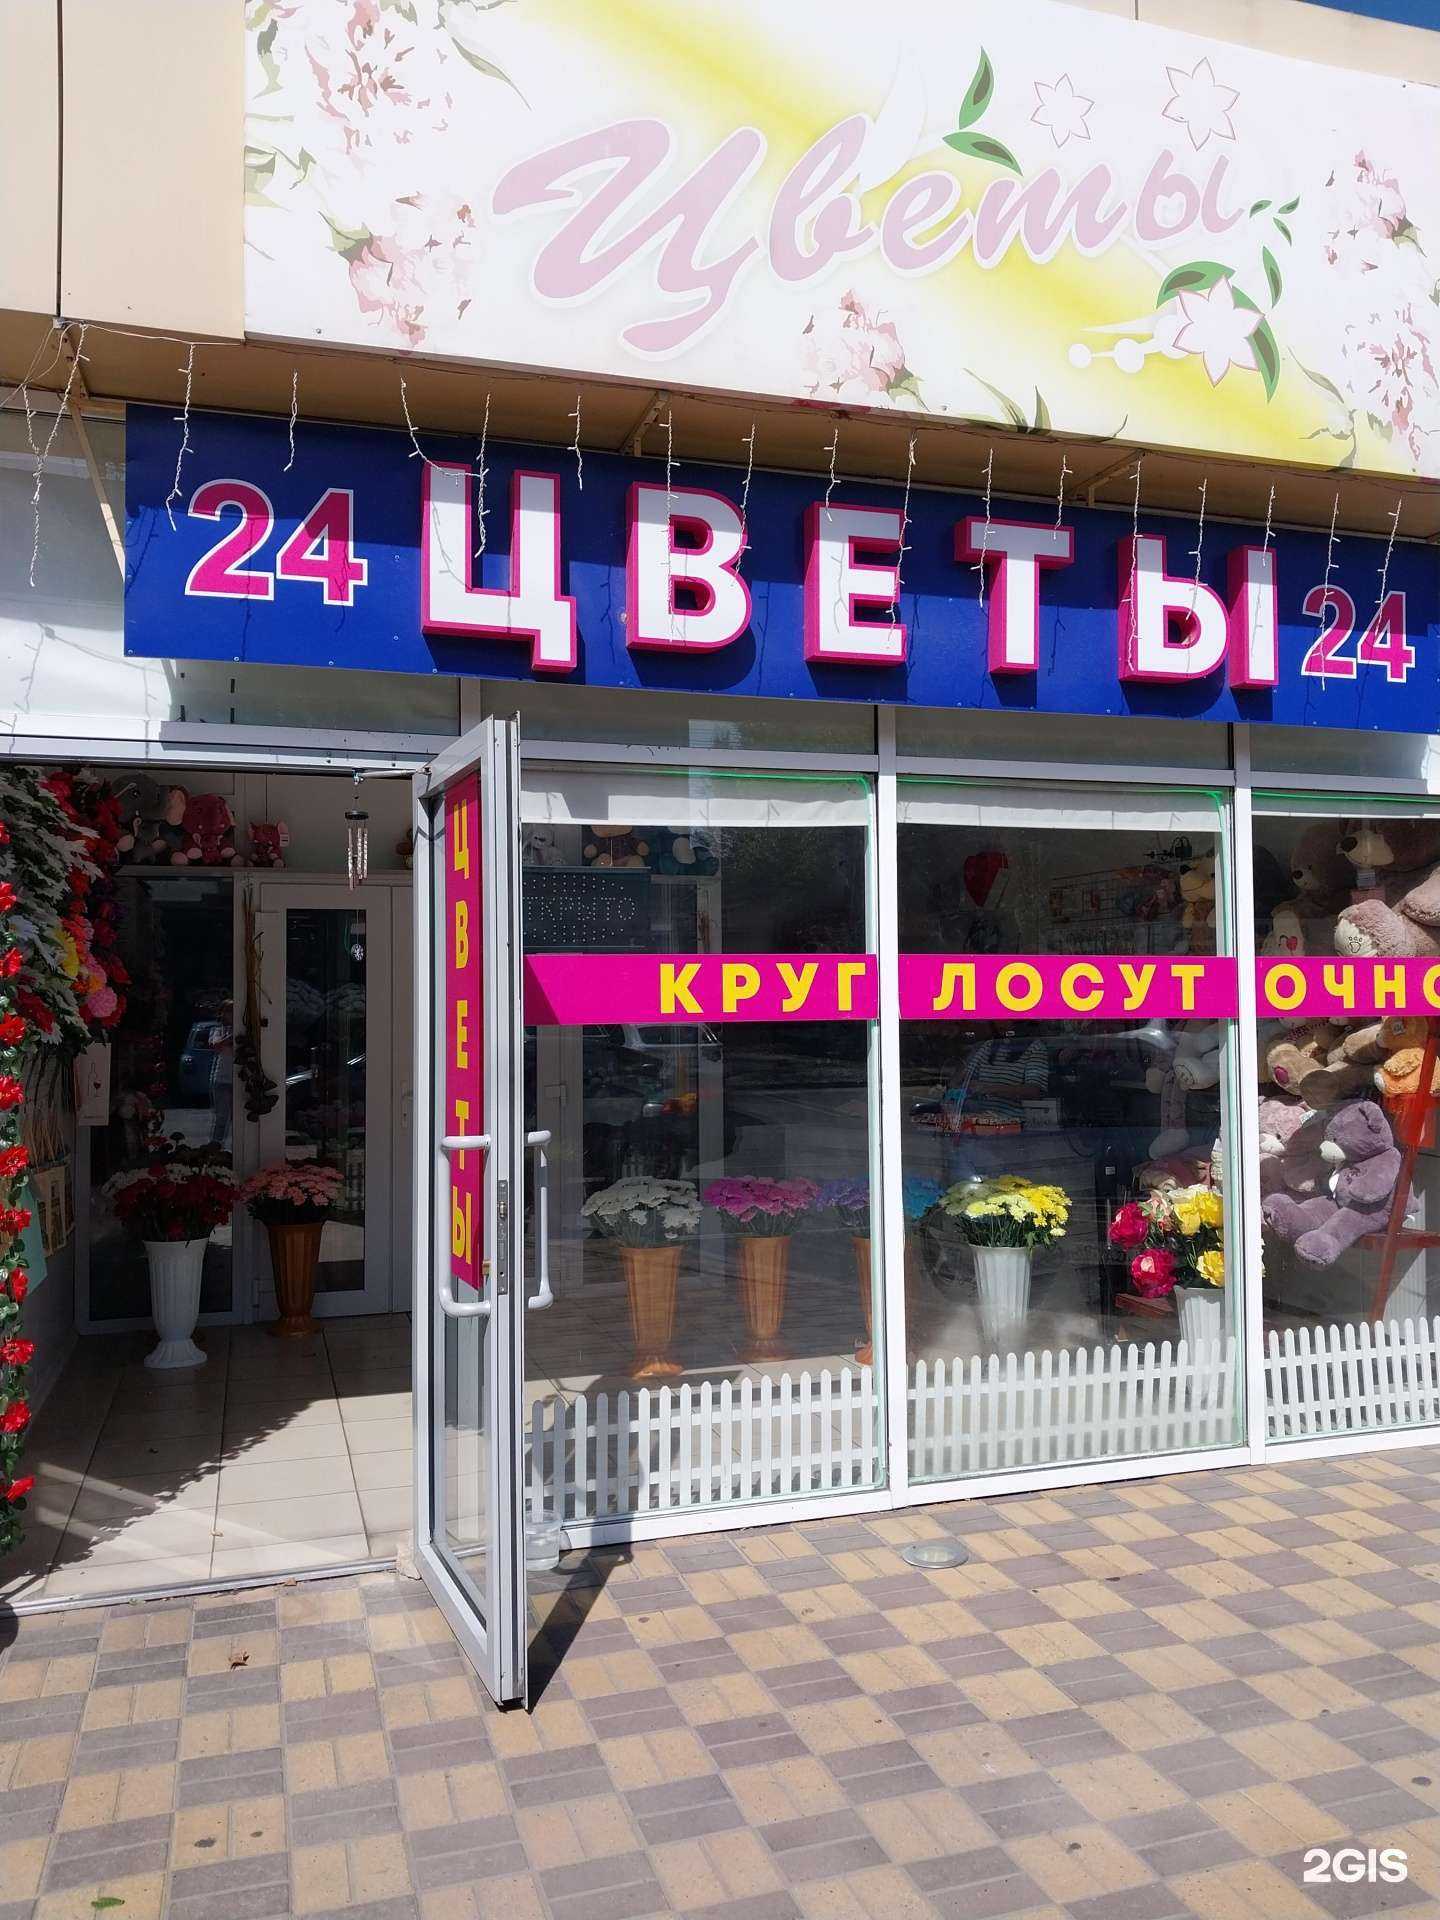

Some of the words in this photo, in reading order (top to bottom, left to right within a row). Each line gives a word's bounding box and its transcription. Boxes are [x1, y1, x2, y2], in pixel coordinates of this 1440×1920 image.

[491, 117, 1246, 354] Цветы
[184, 478, 368, 607] 24
[420, 461, 1280, 690] ЦВЕТЫ
[1301, 585, 1415, 683] 24
[522, 896, 636, 920] ТКРЫТО
[451, 799, 472, 1265] ЦВЕТЫ
